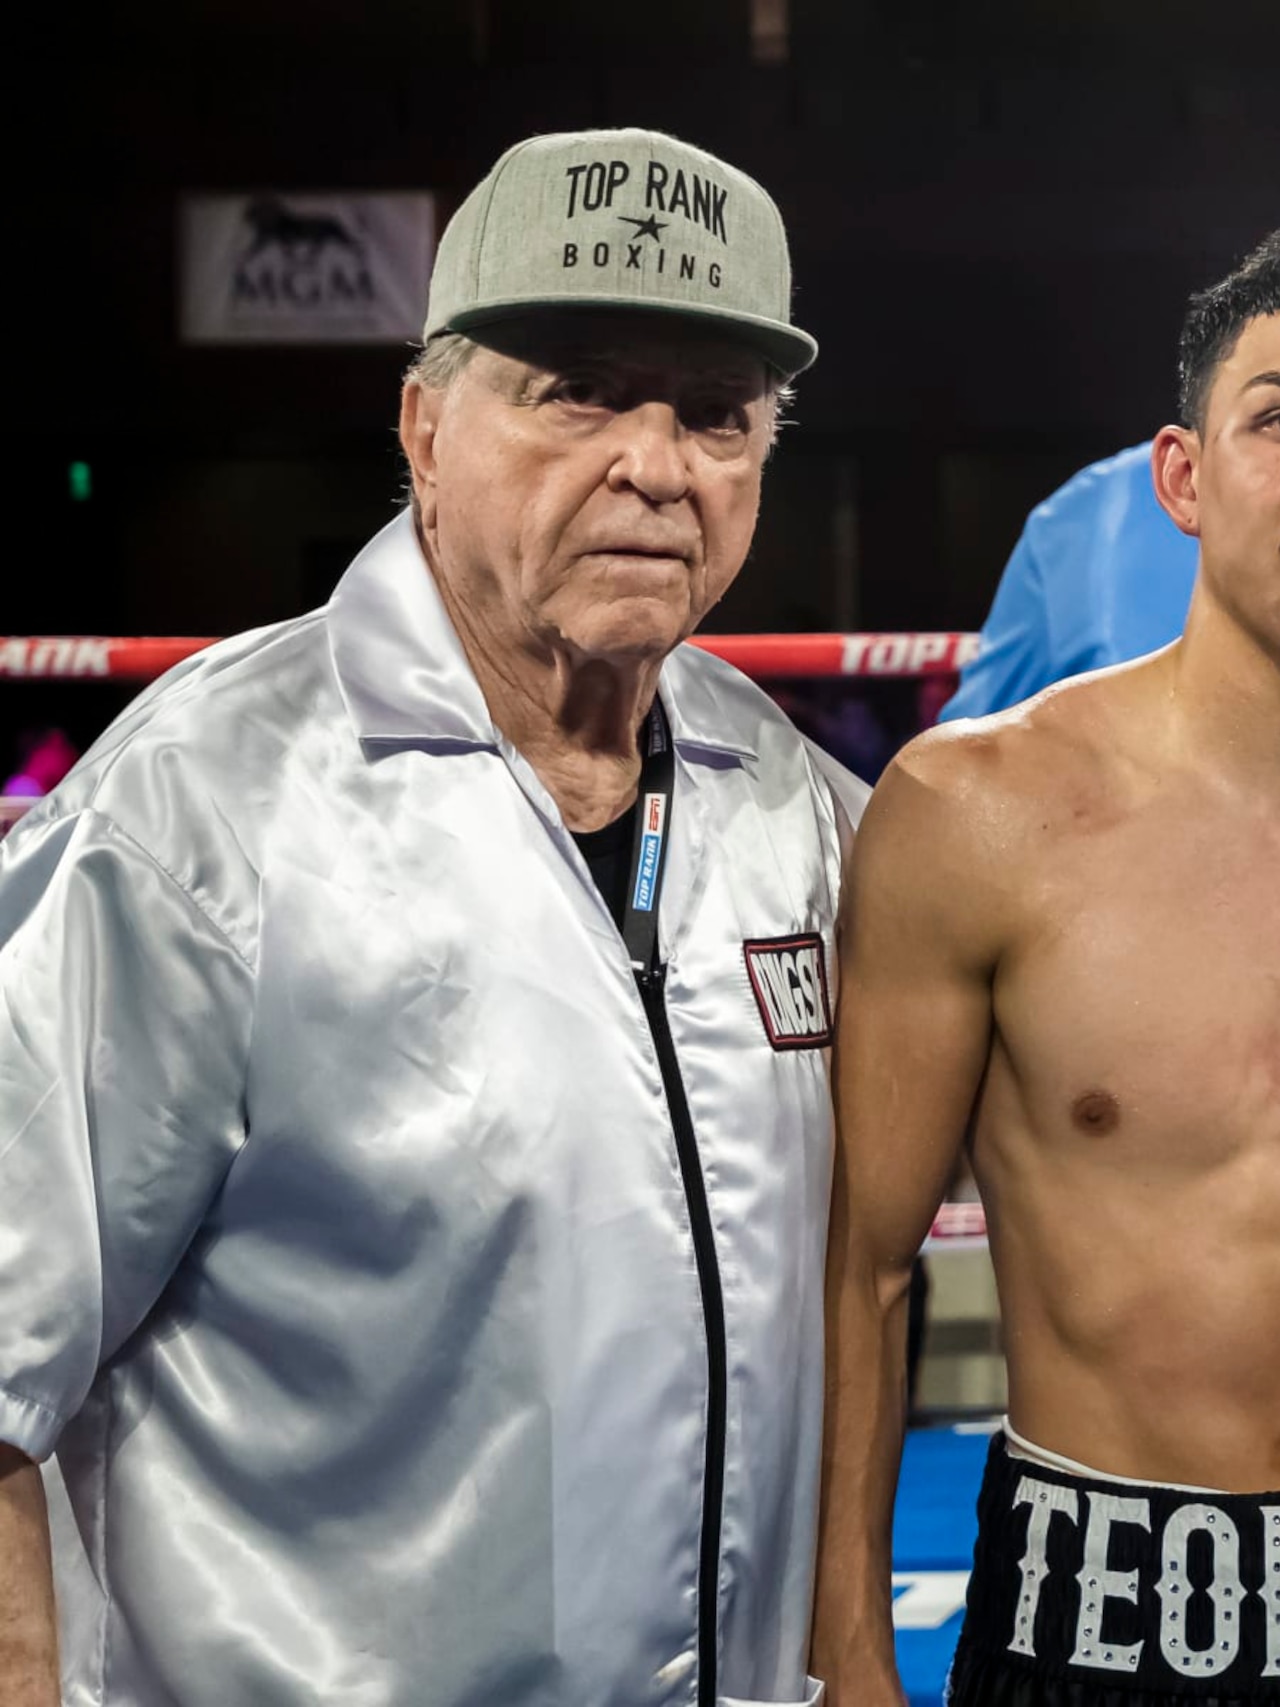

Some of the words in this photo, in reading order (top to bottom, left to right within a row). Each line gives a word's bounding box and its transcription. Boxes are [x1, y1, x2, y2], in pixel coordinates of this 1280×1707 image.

[566, 161, 629, 219] TOP
[645, 160, 728, 246] RANK
[563, 242, 722, 288] BOXING
[0, 636, 110, 677] ANK
[842, 634, 949, 675] TOP
[643, 839, 657, 878] RANK
[637, 879, 651, 909] TOP
